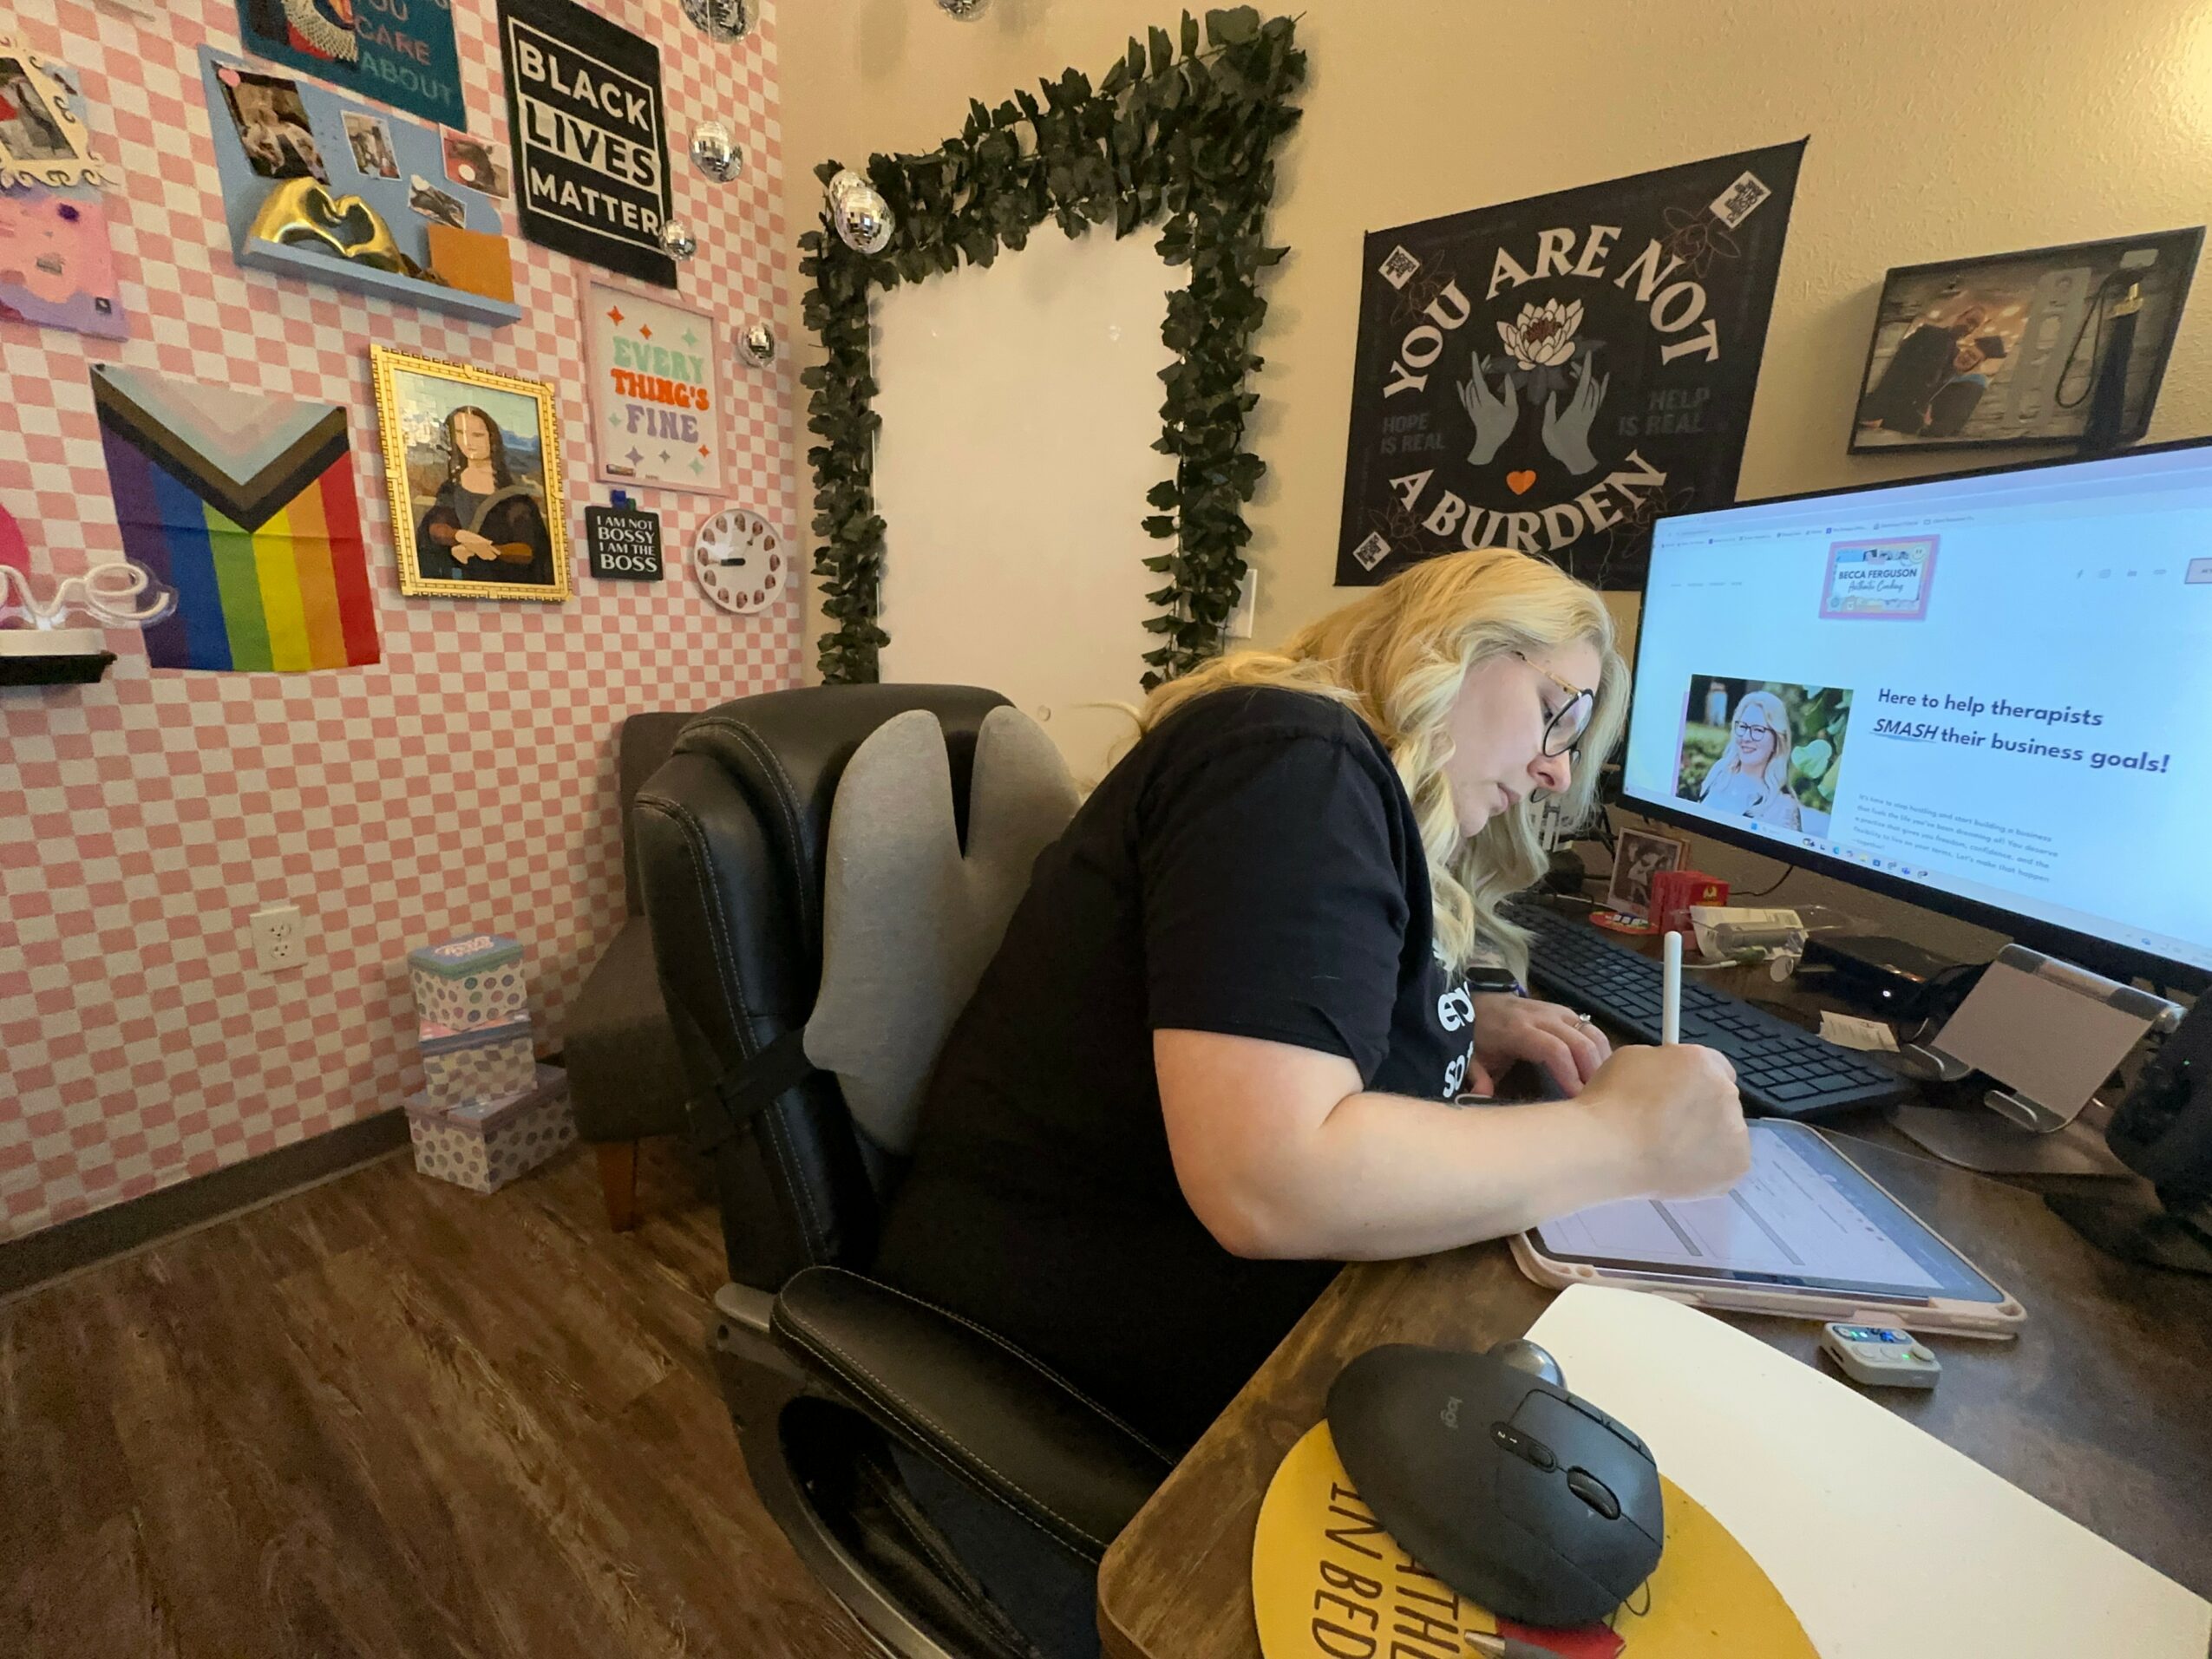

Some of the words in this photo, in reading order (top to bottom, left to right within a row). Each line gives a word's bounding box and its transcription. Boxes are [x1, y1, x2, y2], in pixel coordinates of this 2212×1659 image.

[354, 14, 431, 66] CARE
[360, 50, 452, 106] ABOUT
[519, 39, 650, 131] BLACK
[526, 98, 656, 187] LIVES
[530, 166, 659, 237] MATTER
[1383, 279, 1471, 398] YOU
[1485, 225, 1623, 300] ARE
[1613, 238, 1719, 366] NOT
[612, 336, 704, 384] EVERY
[610, 368, 710, 411] THING'S
[1650, 387, 1711, 411] HELP
[625, 403, 699, 443] FINE
[1382, 412, 1430, 434] HOPE
[1619, 416, 1639, 436] IS
[1645, 413, 1705, 435] REAL
[1380, 436, 1397, 454] IS
[1402, 432, 1446, 453] REAL
[1390, 468, 1435, 513] A
[1422, 448, 1667, 553] BURDEN
[596, 515, 601, 526] I
[605, 516, 625, 527] AM
[628, 518, 653, 531] NOT
[598, 526, 655, 545] BOSSY
[599, 541, 604, 552] I
[607, 542, 628, 553] AM
[632, 544, 656, 556] THE
[600, 553, 658, 572] BOSS
[0, 564, 171, 620] ve
[1838, 571, 1866, 579] BECCA
[1867, 568, 1918, 578] FERGUSON
[1877, 688, 1916, 706] Here
[1921, 694, 1940, 708] to
[1944, 694, 1985, 717] help
[1991, 699, 2104, 726] therapists
[1873, 718, 1940, 740] SMASH
[1940, 727, 1986, 748] their
[1991, 732, 2084, 761] business
[2089, 751, 2171, 774] goals!
[2016, 828, 2052, 843] business
[2017, 856, 2033, 865] and
[2035, 859, 2049, 869] the
[1440, 1395, 1463, 1429] logi
[1312, 1560, 1383, 1659] BED
